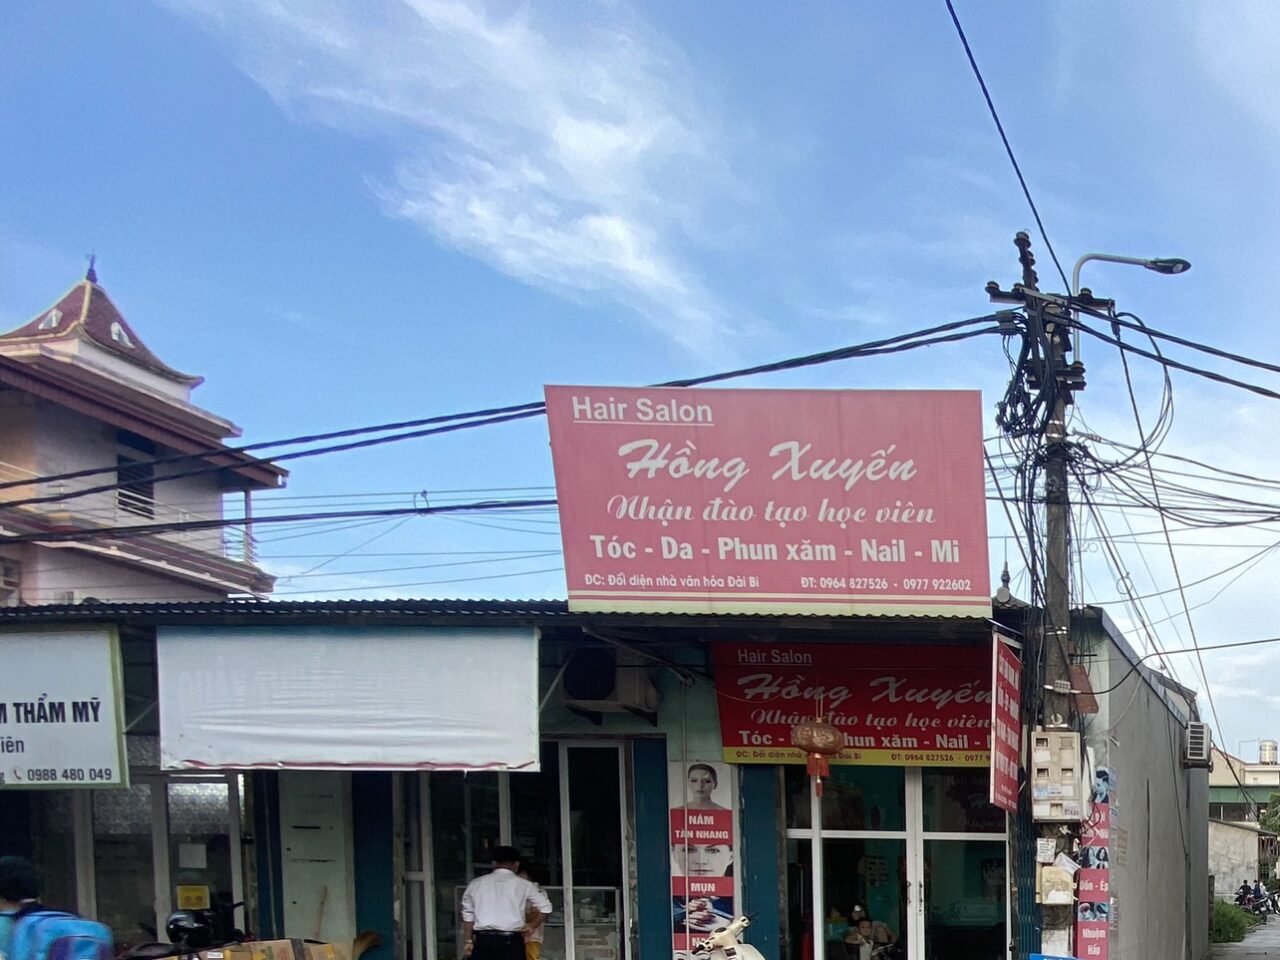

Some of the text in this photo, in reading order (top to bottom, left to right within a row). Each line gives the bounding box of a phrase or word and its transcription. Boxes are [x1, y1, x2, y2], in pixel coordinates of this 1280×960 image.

[572, 396, 713, 422] Hair Salon
[618, 439, 917, 493] Hồng Xuyến
[607, 494, 936, 529] Nhận đào tạo học viên
[589, 535, 637, 559] Tóc
[661, 536, 693, 559] Da
[718, 537, 778, 560] Phun
[786, 539, 836, 561] xăm
[860, 538, 906, 562] Nail
[931, 539, 960, 563] Mi
[585, 574, 605, 585] ĐC:
[629, 574, 653, 589] diện
[656, 574, 677, 587] nhà
[680, 575, 700, 587] văn
[703, 575, 725, 587] hóa
[727, 575, 746, 588] Đài
[749, 576, 759, 588] Bi
[801, 577, 817, 588] ĐT:
[820, 577, 846, 589] 0964
[849, 577, 888, 589] 827526
[904, 579, 928, 590] 0977
[932, 579, 971, 591] 922602
[738, 649, 812, 663] Hair Salon
[737, 673, 853, 709] Hồng
[13, 693, 66, 723] THẨM
[72, 697, 101, 722] MỸ
[866, 713, 898, 730] tạo
[905, 712, 940, 731] học
[947, 714, 991, 728] viên
[738, 730, 773, 745] Tóc
[844, 732, 875, 747] hun
[881, 734, 918, 748] xăm
[935, 734, 968, 749] Nail
[964, 754, 982, 762] 0977
[27, 768, 112, 781] 0988 480 049
[696, 830, 729, 839] NHANG
[691, 882, 716, 895] MỤN
